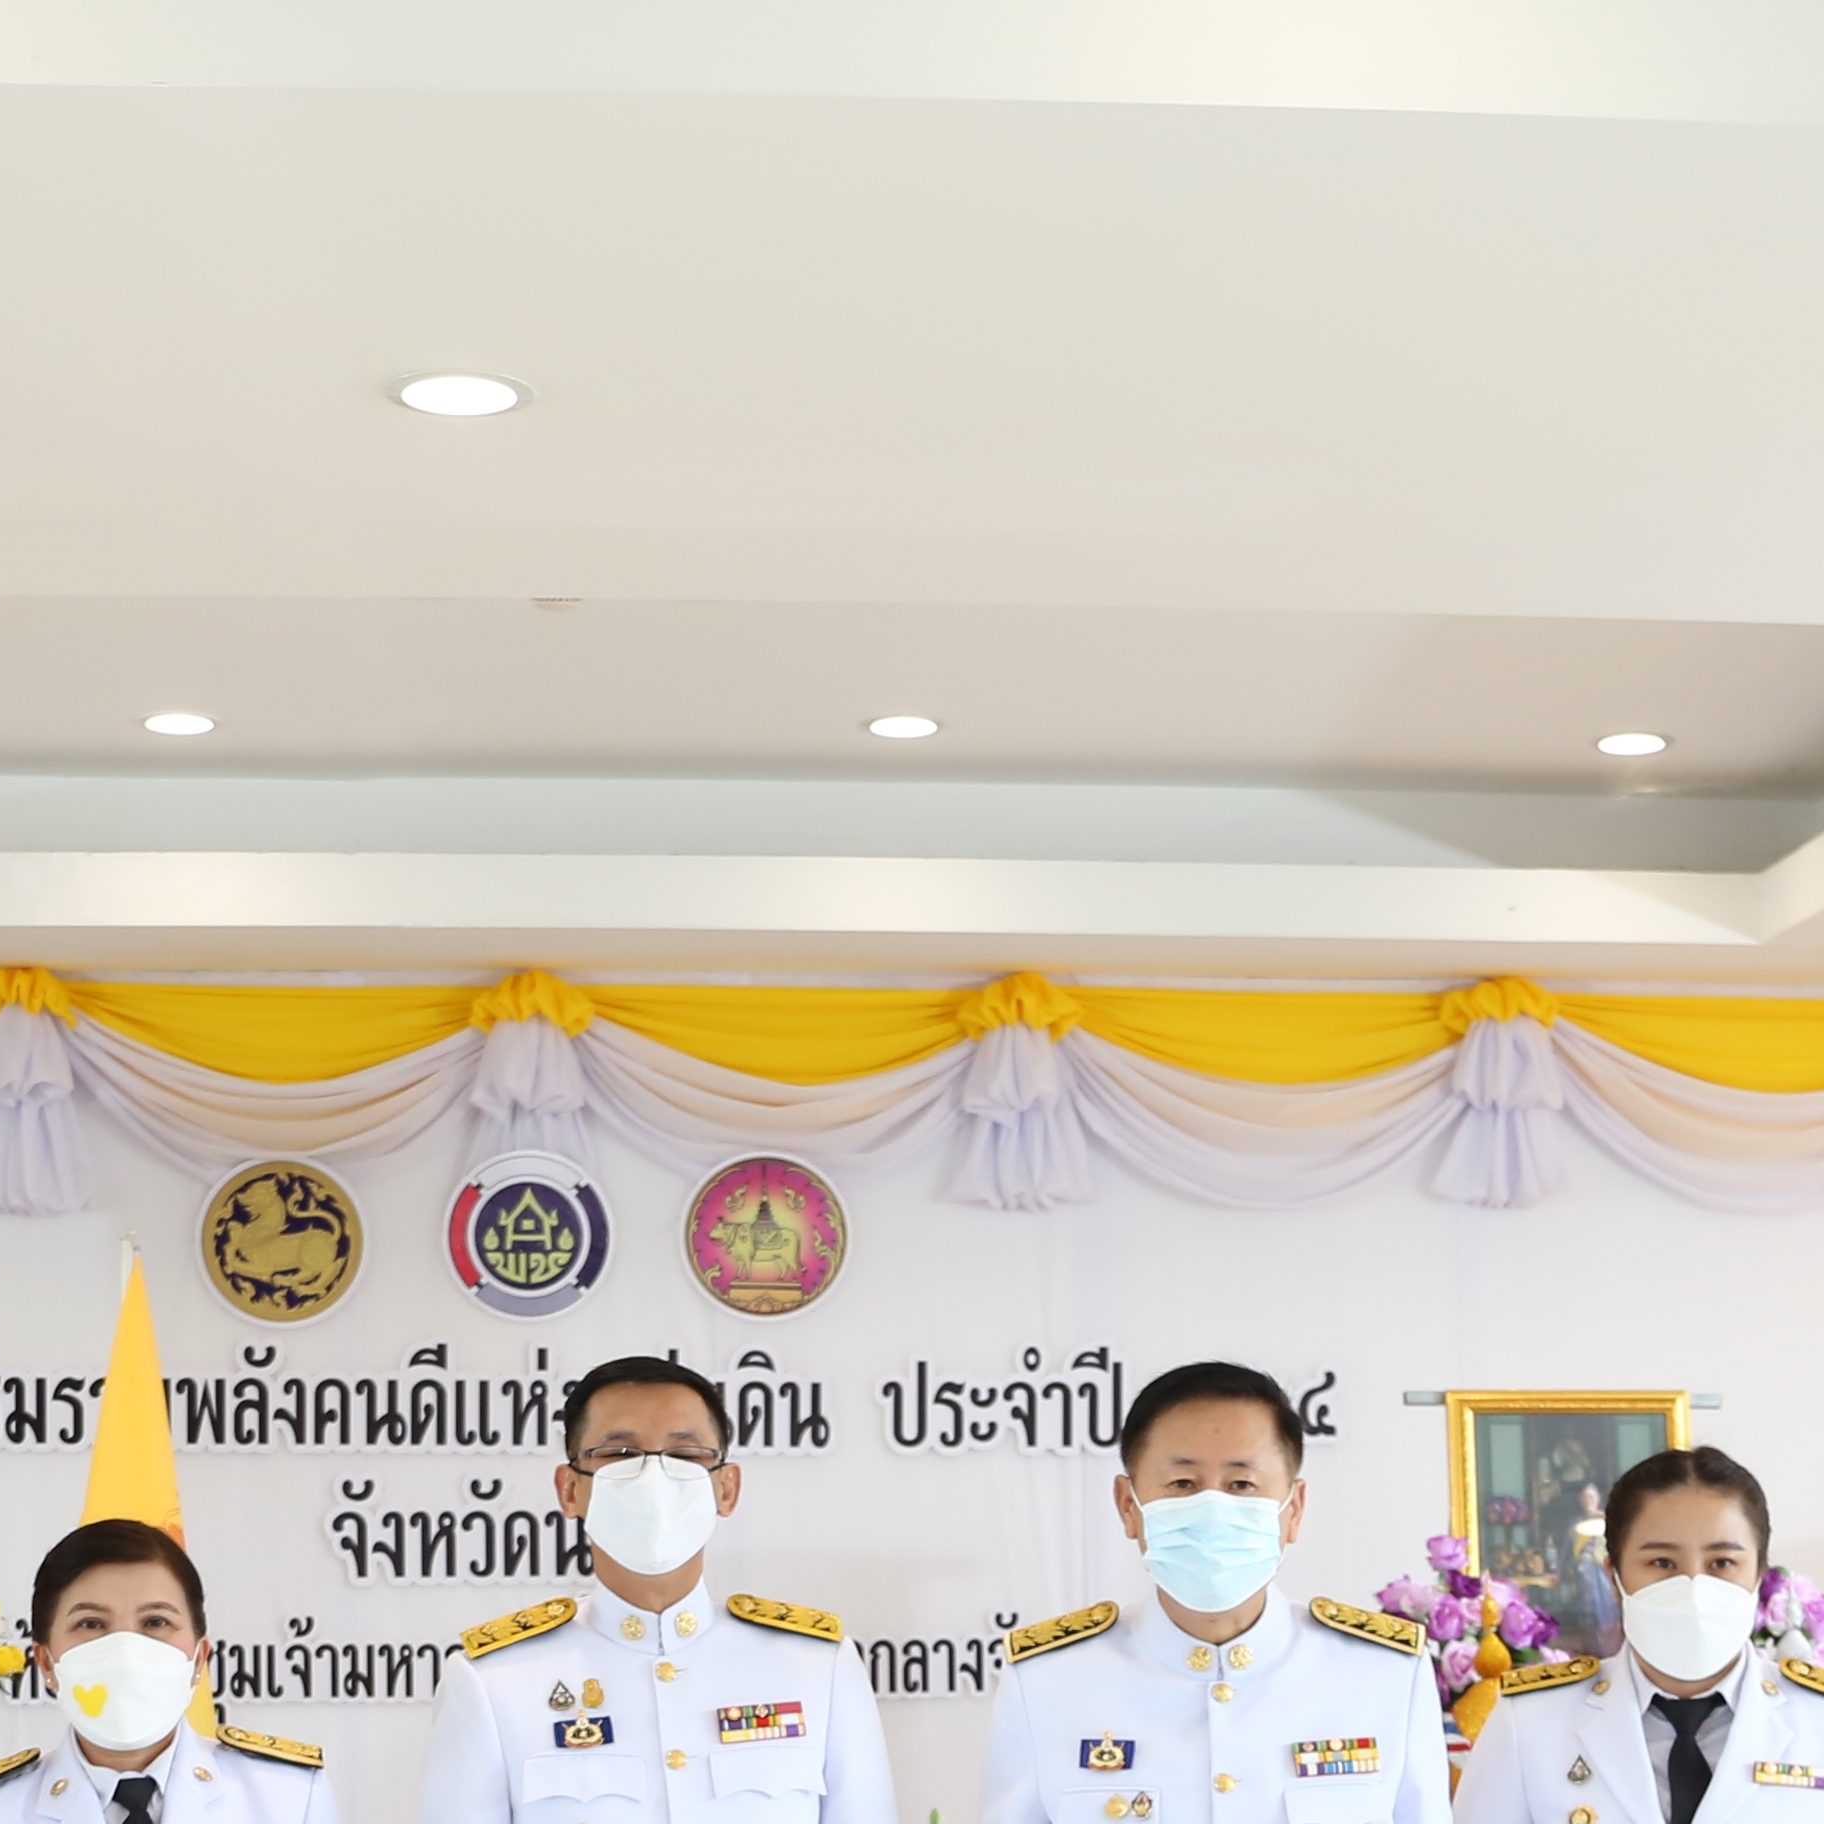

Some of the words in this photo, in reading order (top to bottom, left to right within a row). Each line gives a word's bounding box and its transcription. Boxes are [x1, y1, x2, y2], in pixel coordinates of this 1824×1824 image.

[882, 1346, 1122, 1447] ประจำปี
[332, 1478, 594, 1577] จังหวัดน
